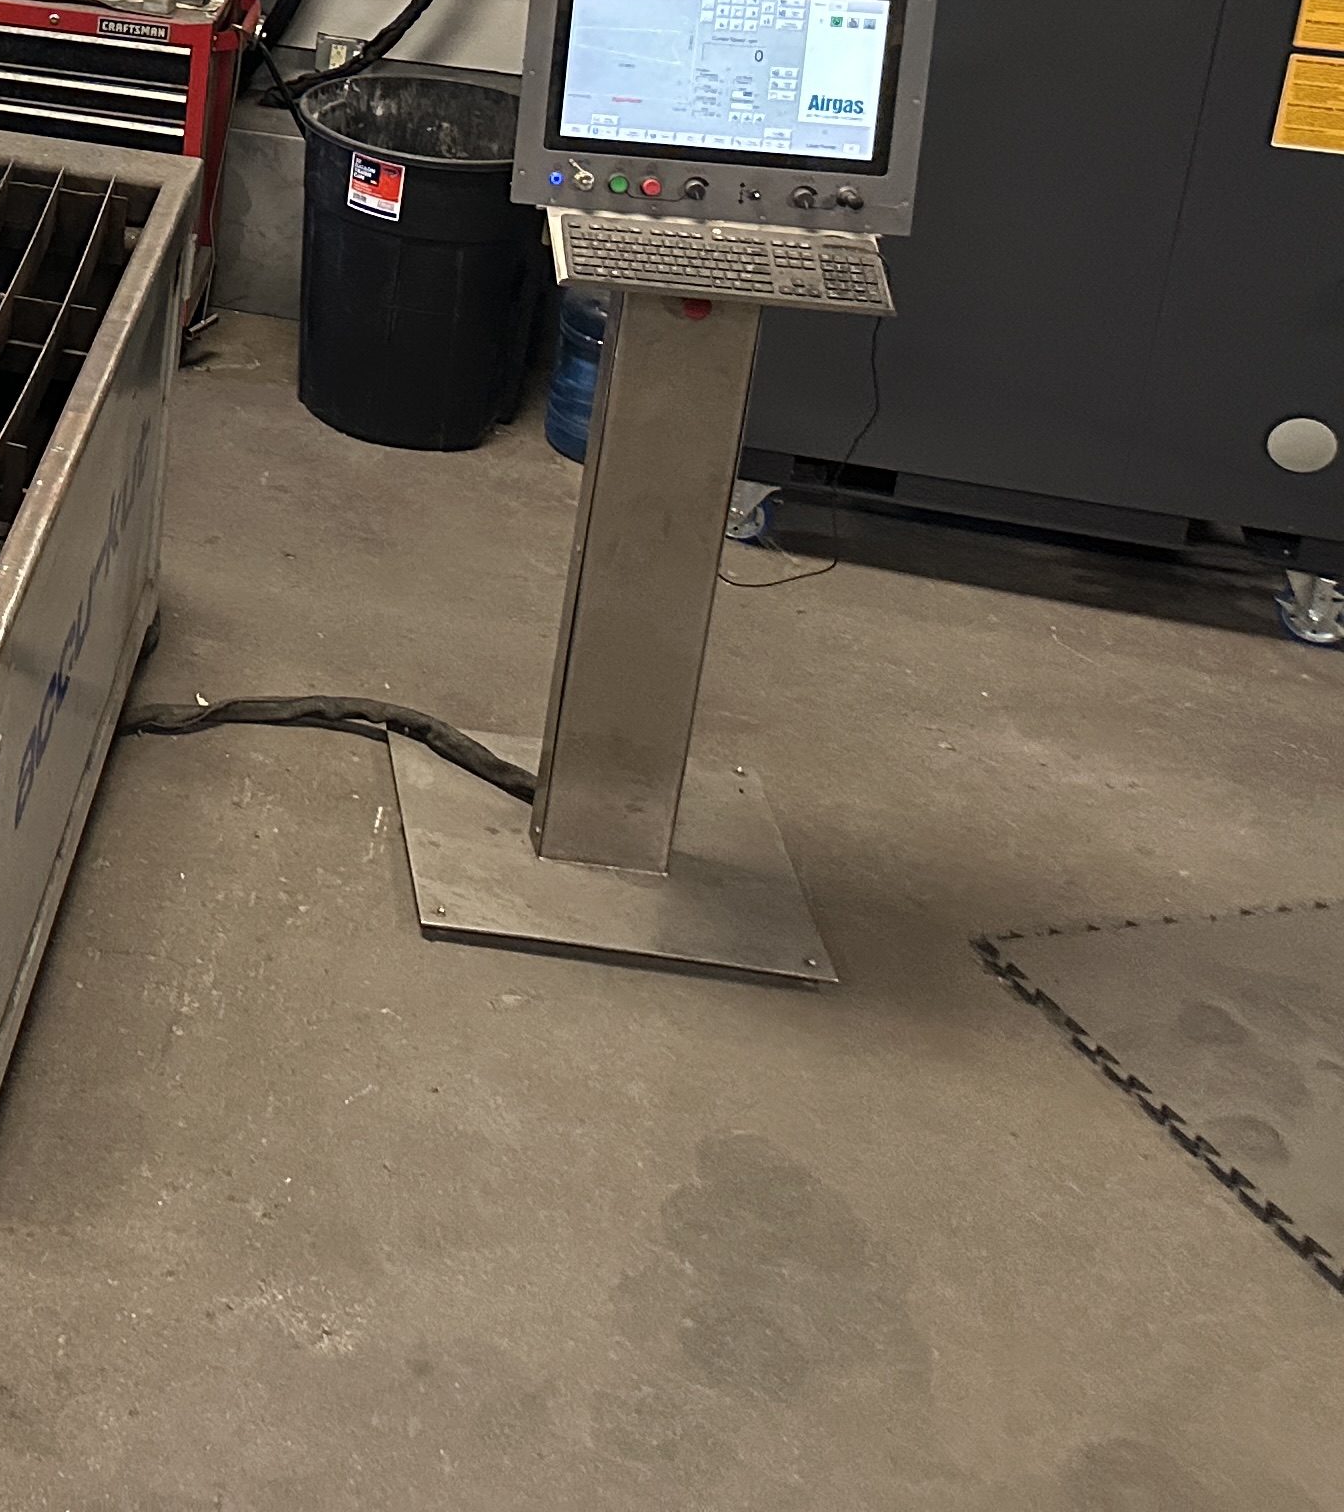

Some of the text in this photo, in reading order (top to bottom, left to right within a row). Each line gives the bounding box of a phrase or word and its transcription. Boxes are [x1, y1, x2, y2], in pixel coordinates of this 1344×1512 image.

[101, 21, 166, 38] CRAFTSMAN
[754, 49, 764, 62] 0
[808, 94, 864, 115] Airgas
